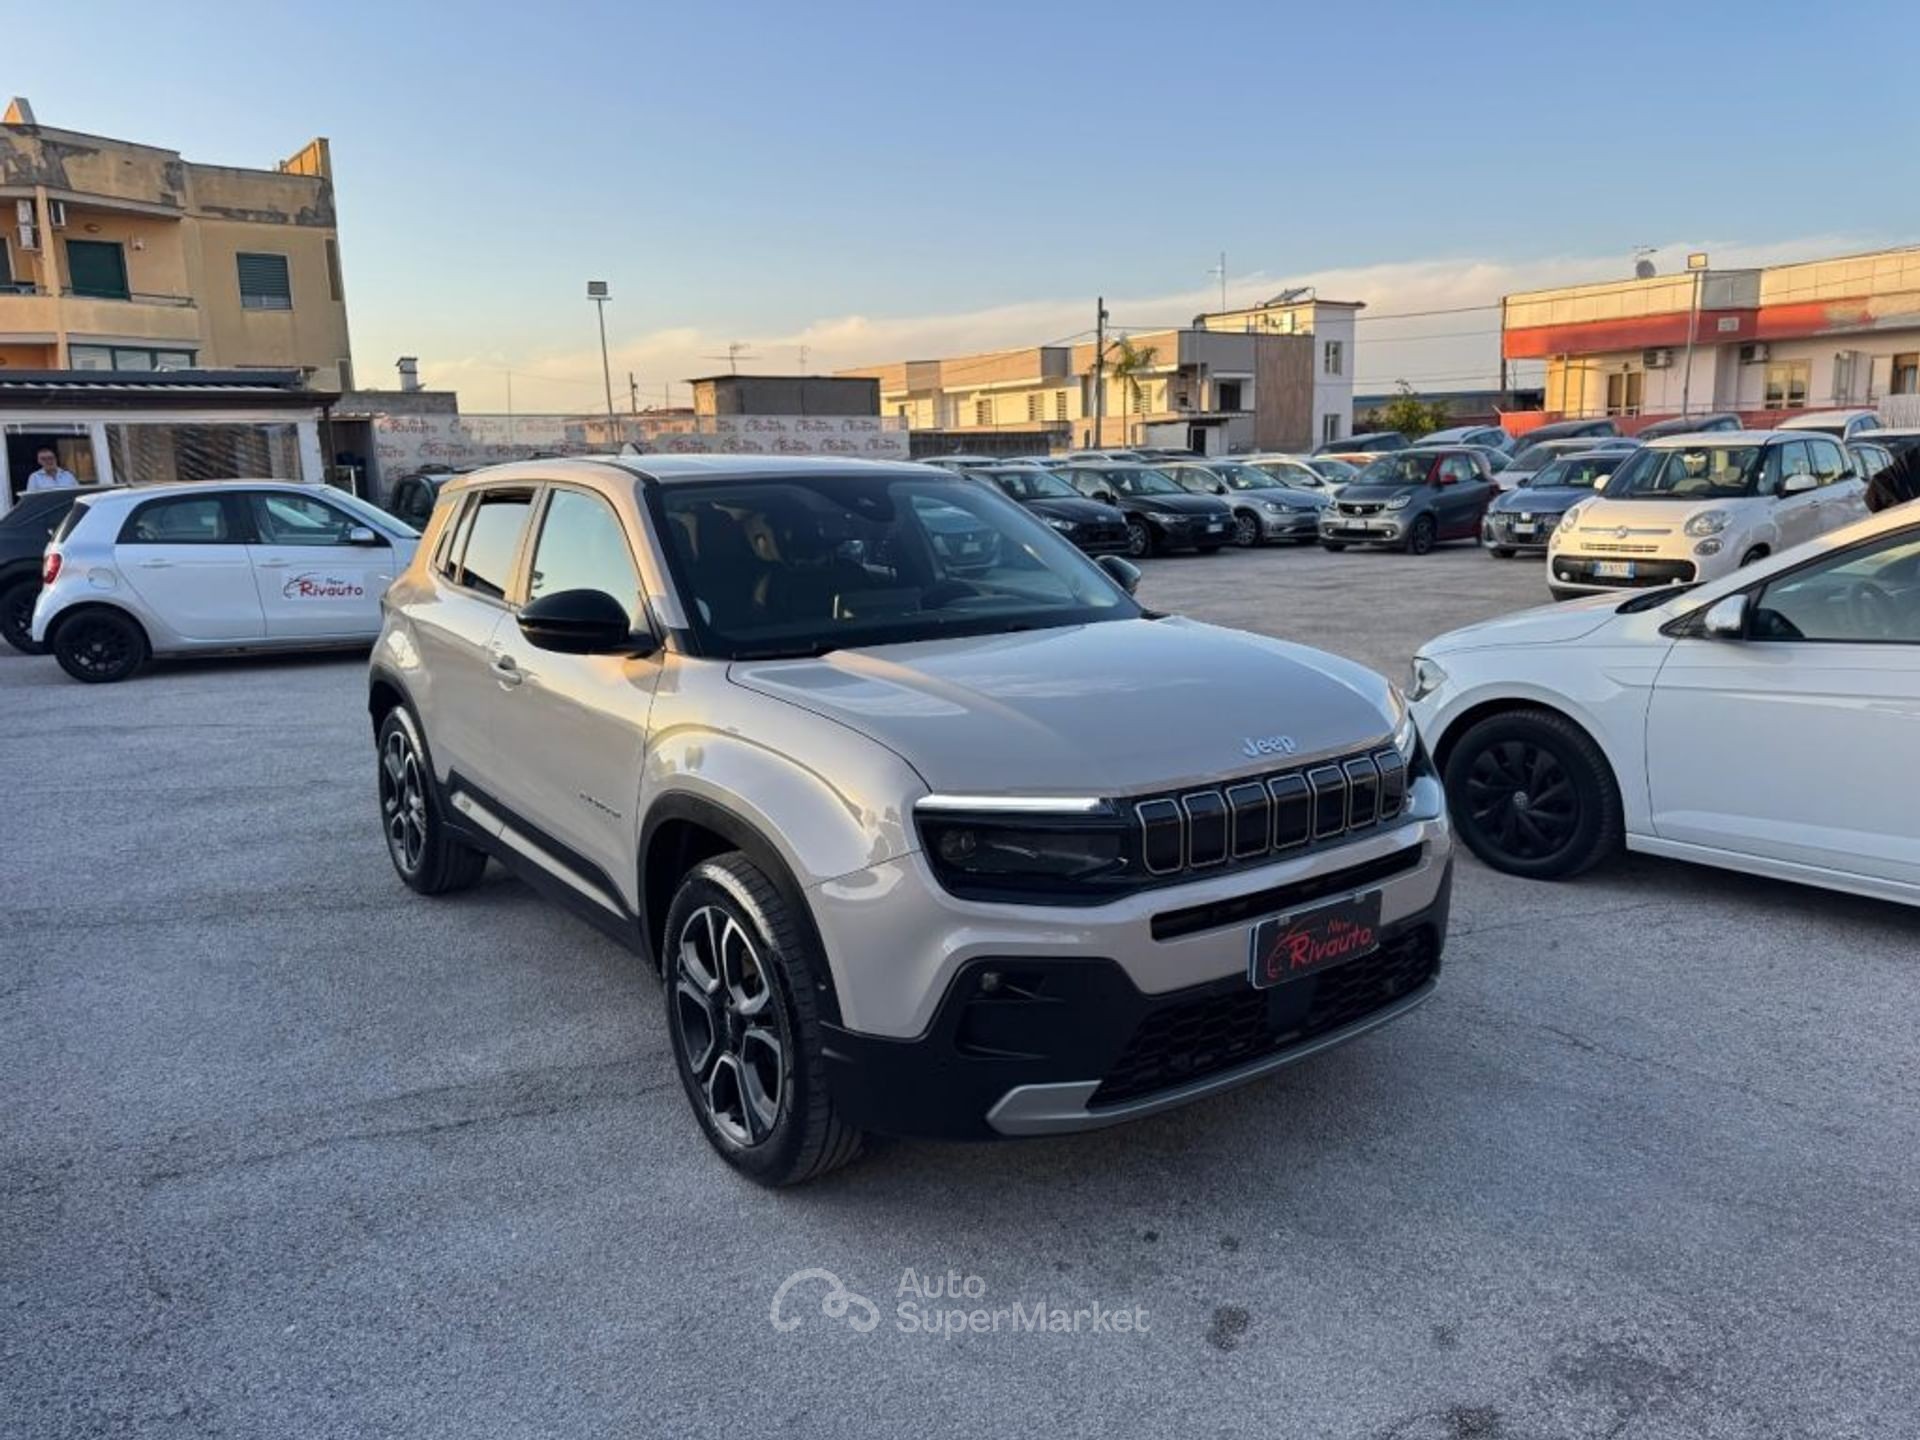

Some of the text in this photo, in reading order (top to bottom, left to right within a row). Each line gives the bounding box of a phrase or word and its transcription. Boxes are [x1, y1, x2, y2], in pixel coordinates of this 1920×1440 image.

[300, 580, 364, 597] Rivauto
[1243, 736, 1296, 757] Jeep
[1288, 925, 1373, 969] Rivauto
